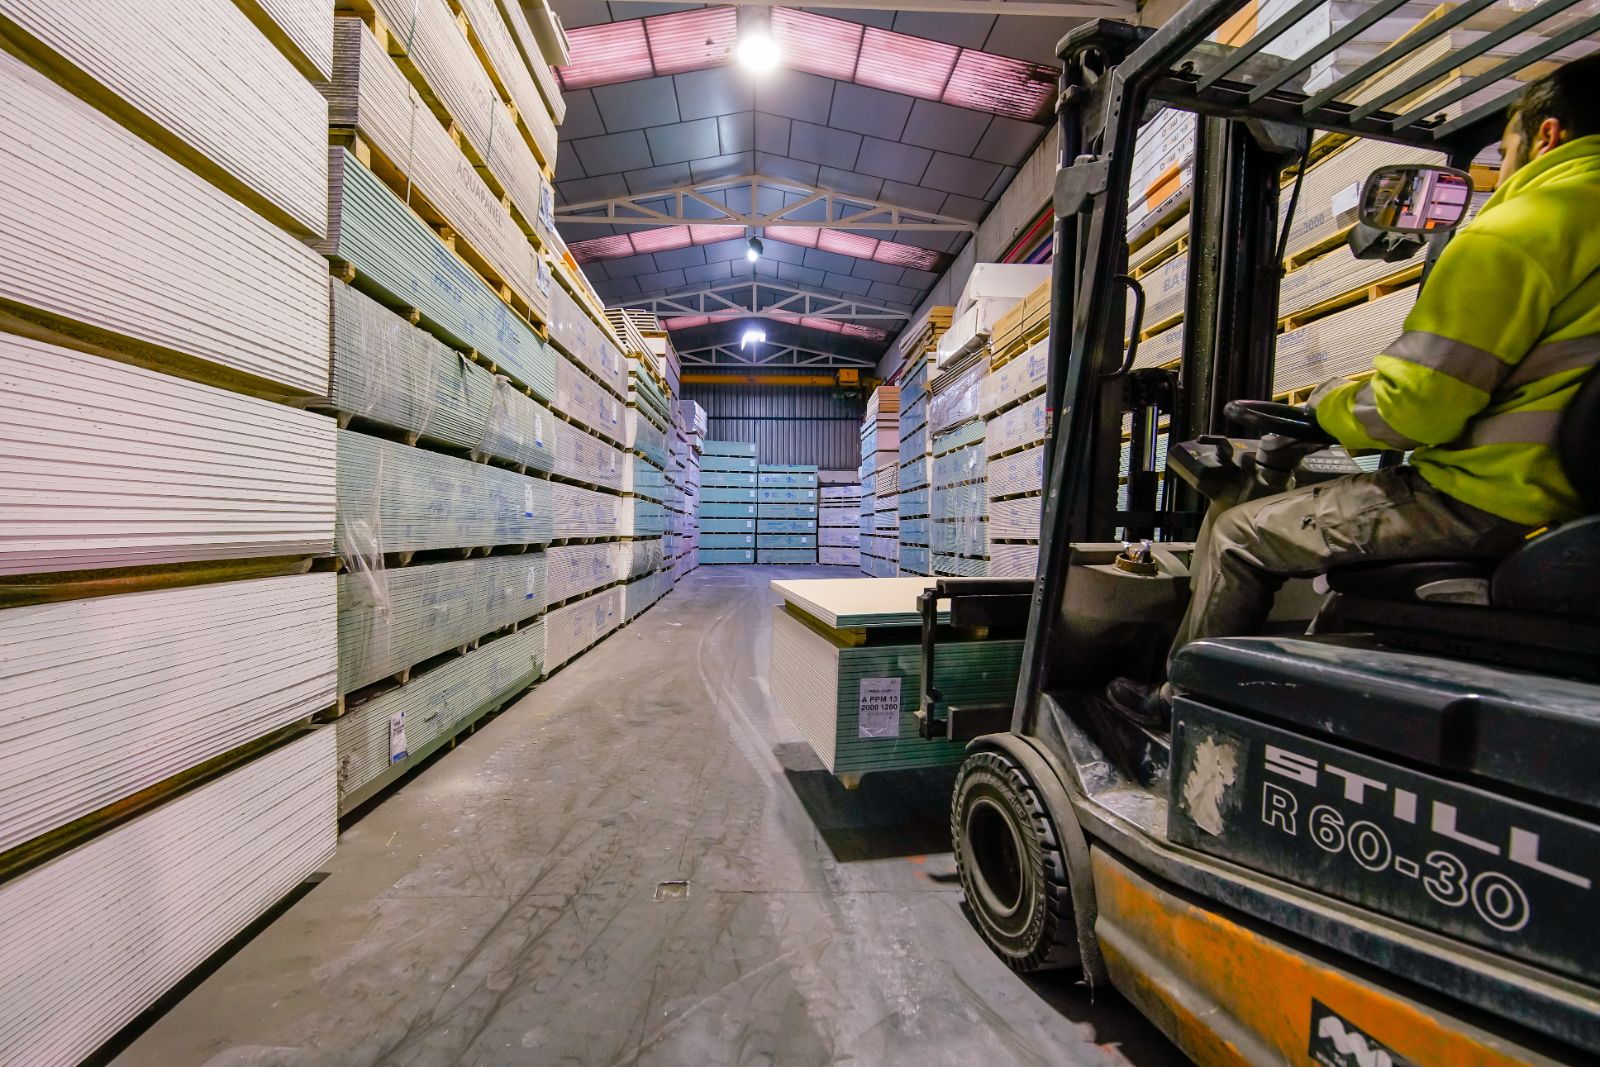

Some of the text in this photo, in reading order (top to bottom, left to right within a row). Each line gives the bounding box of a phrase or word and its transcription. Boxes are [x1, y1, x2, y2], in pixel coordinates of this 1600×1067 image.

[457, 160, 502, 227] AQUAPANEL
[881, 703, 898, 711] 1200
[1262, 781, 1531, 932] R 60-30
[1264, 744, 1592, 890] STILL
